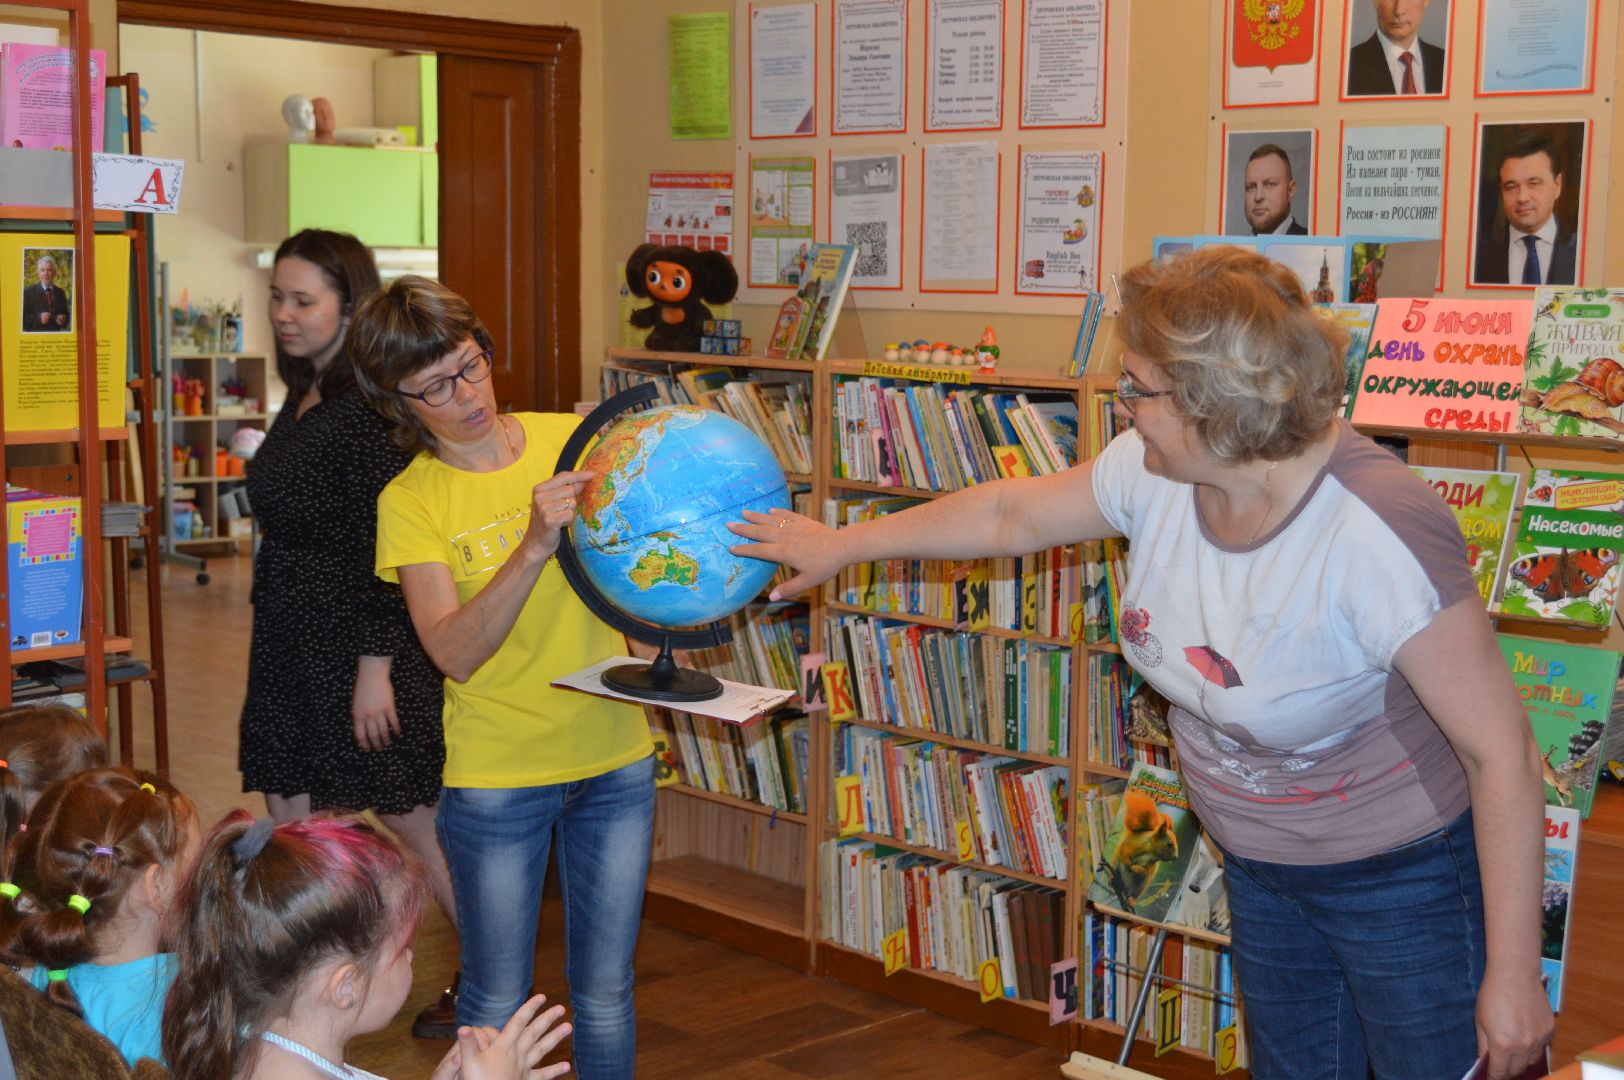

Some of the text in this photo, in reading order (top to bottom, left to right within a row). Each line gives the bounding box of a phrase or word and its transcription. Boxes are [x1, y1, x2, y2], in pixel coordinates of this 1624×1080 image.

[1347, 146, 1440, 164] Роса состоит из росинок
[134, 167, 170, 205] А
[1346, 163, 1356, 178] Из
[1359, 167, 1388, 178] капелек
[1390, 167, 1408, 181] пара
[1346, 182, 1362, 198] Песок
[1373, 182, 1408, 197] мельчайших
[1346, 206, 1374, 220] Россия
[1380, 210, 1390, 220] из
[1392, 206, 1438, 220] РОССИЯН!
[1046, 250, 1068, 260] English
[1402, 300, 1429, 333] 5
[1547, 324, 1622, 341] ЖИВАЯ
[1551, 342, 1614, 356] ПРИРОДА
[1428, 480, 1485, 510] ОДИ
[1528, 514, 1623, 538] Насекомые
[1513, 651, 1567, 684] Мир
[806, 665, 826, 704] И
[825, 666, 854, 716] К
[840, 784, 864, 828] Л
[980, 962, 999, 997] О
[1054, 966, 1077, 1016] Ч
